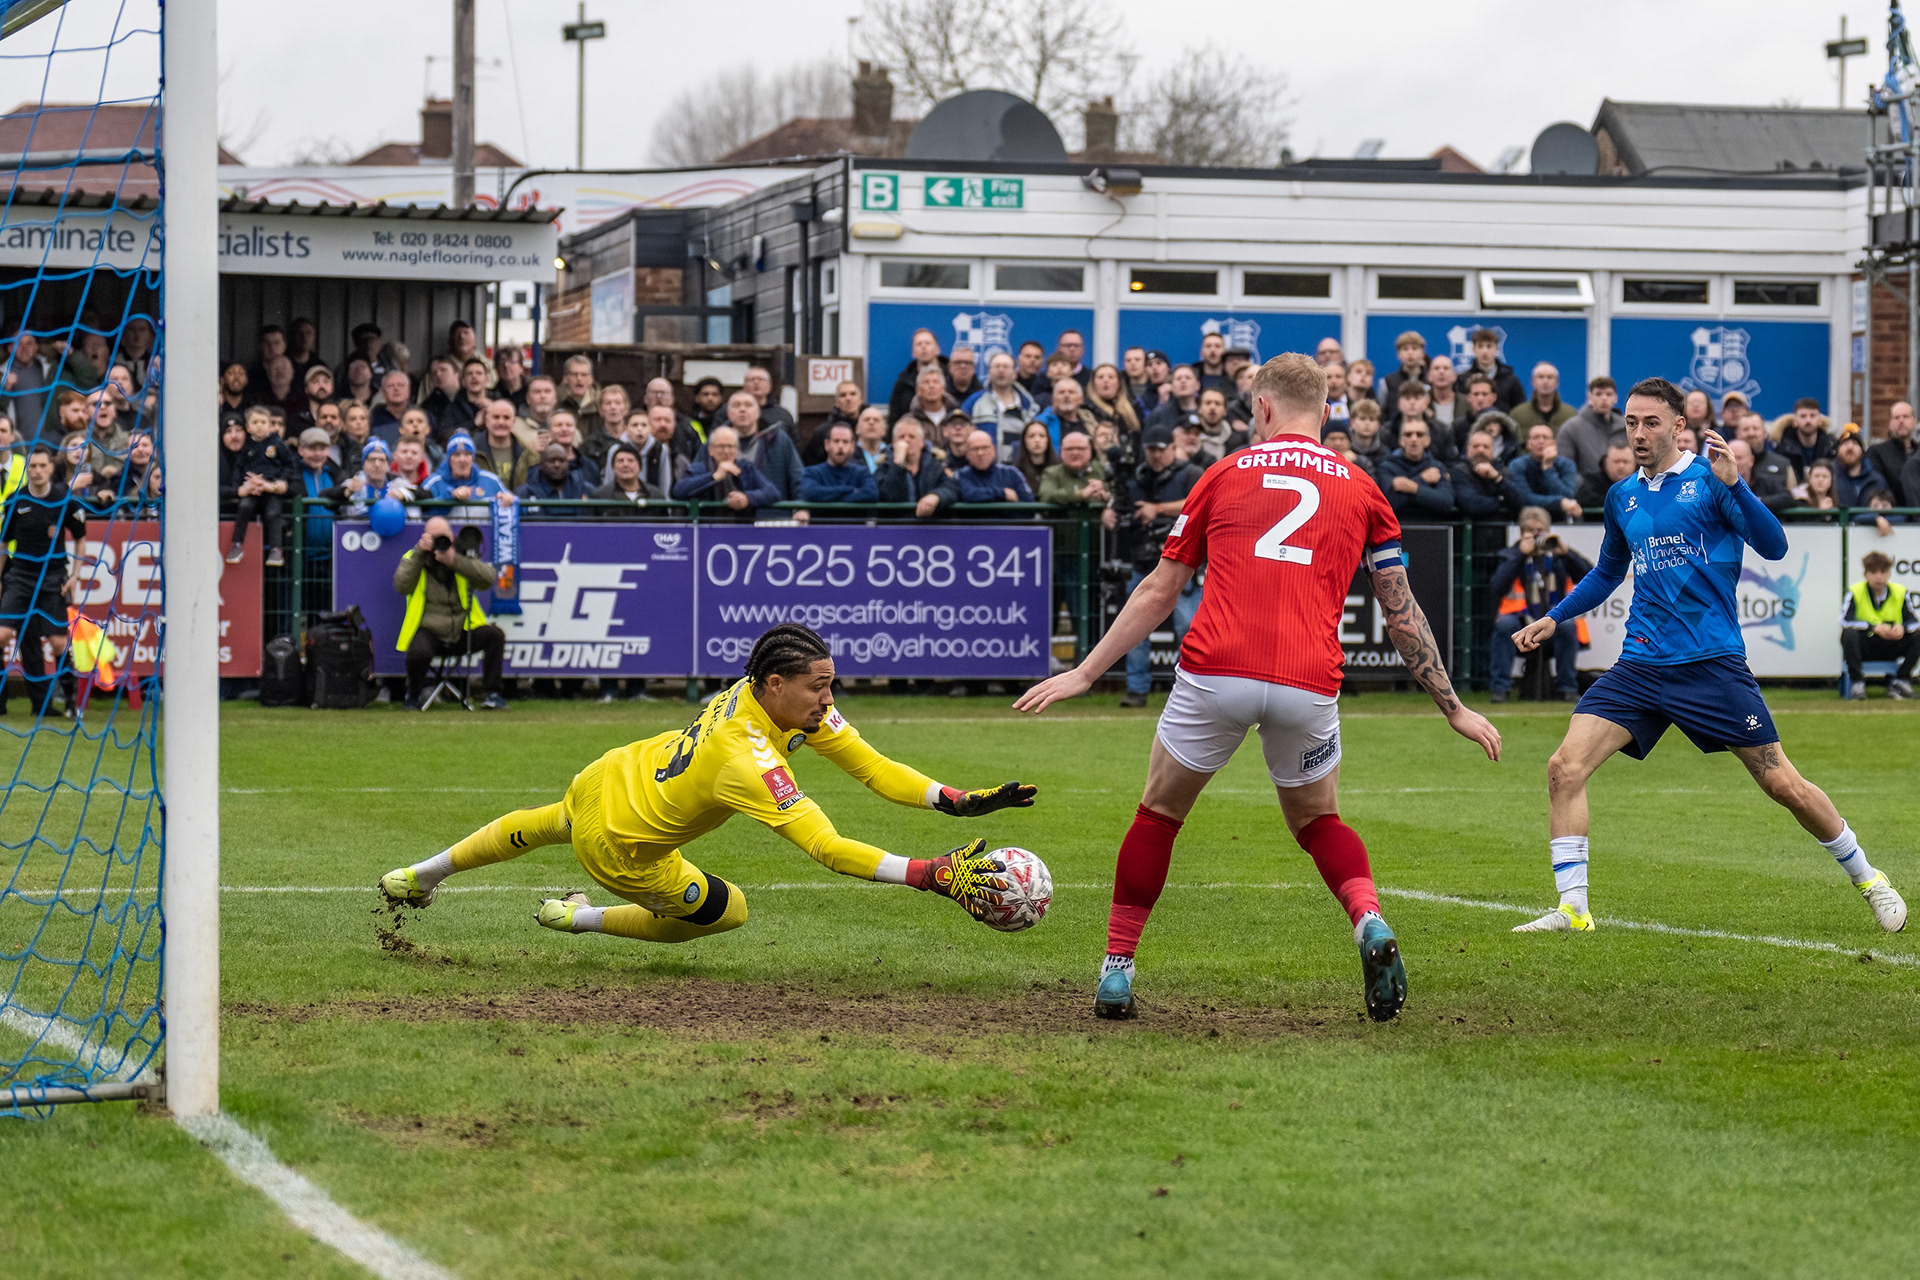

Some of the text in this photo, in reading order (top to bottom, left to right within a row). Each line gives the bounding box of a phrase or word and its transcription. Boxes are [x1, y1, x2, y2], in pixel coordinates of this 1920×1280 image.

[866, 176, 894, 208] B
[991, 180, 1020, 193] Fire
[990, 193, 1019, 206] exit
[372, 231, 513, 248] Tel: 020 8424 0800
[342, 249, 540, 267] www.nagleflooring.co.uk
[811, 363, 849, 381] EXIT
[1236, 451, 1351, 480] GRIMMER
[1254, 473, 1321, 566] 2
[1648, 532, 1686, 549] Brunel
[1650, 545, 1701, 560] University
[706, 543, 1042, 588] 07525 538 341
[719, 599, 1028, 631] www.cgscaffolding.co.uk
